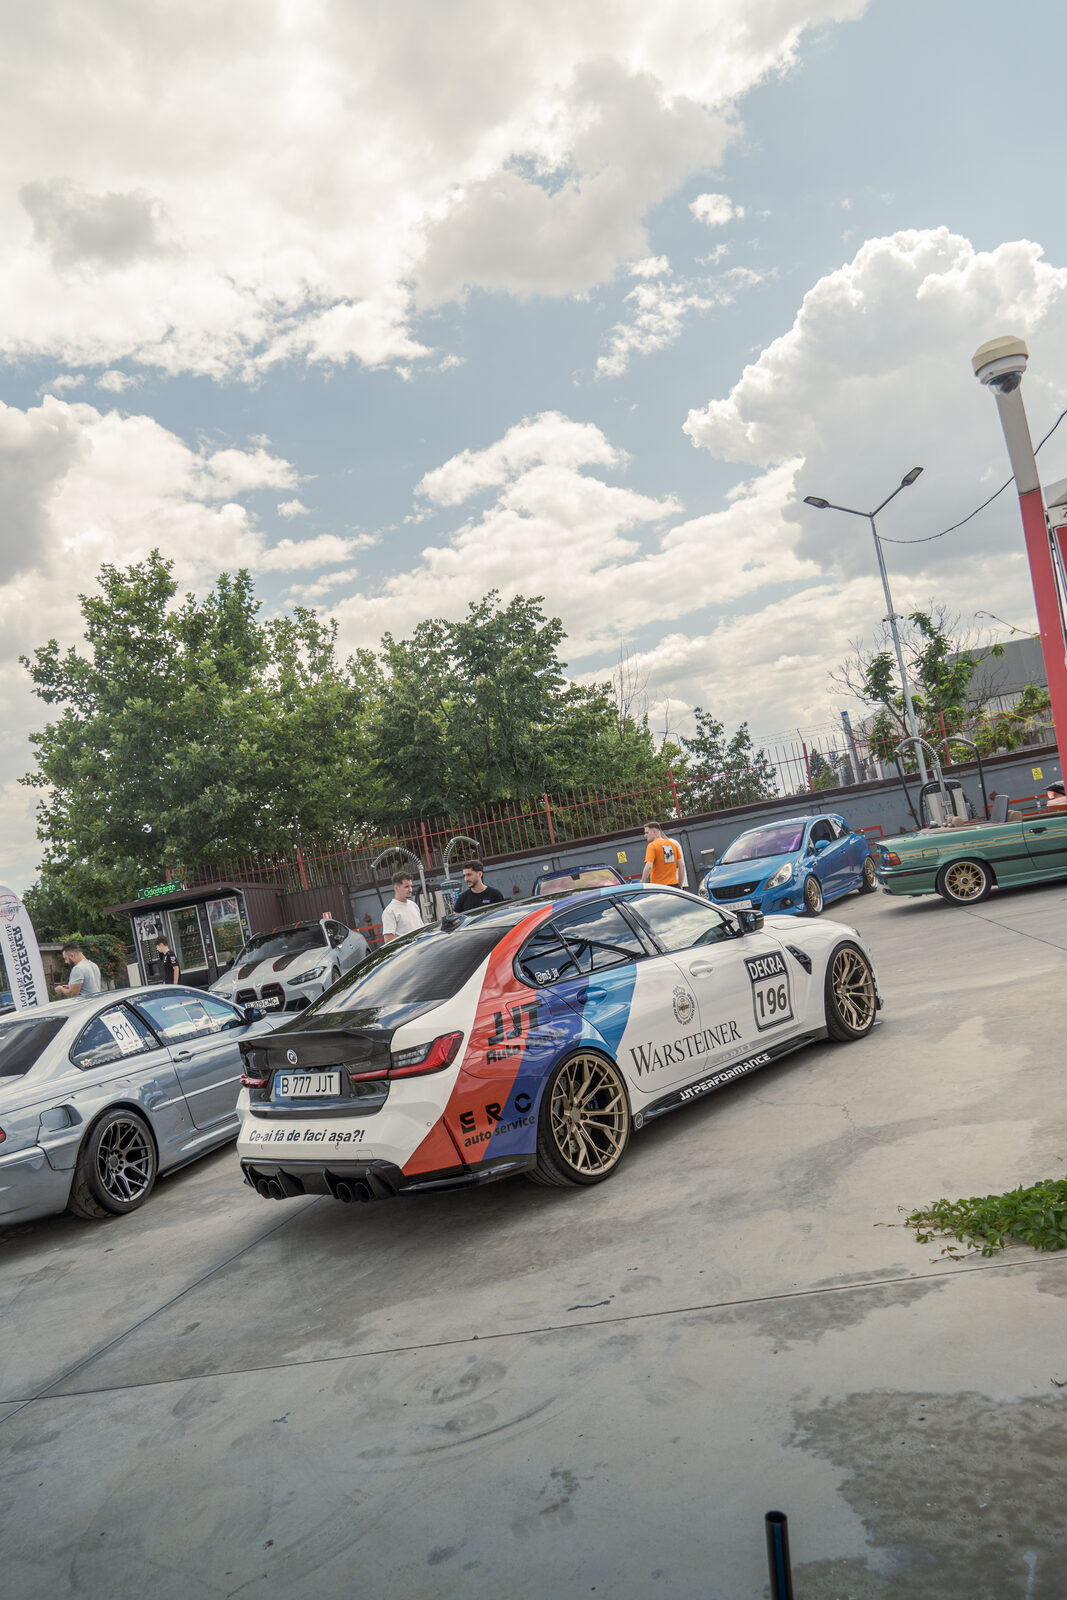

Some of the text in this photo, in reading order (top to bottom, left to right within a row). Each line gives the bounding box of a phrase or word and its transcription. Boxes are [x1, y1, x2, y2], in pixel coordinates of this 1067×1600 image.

[747, 955, 785, 980] DEKRA
[756, 983, 787, 1018] 196
[111, 1022, 136, 1041] 811
[488, 1000, 543, 1047] JJT
[486, 1044, 521, 1065] Auto
[629, 1020, 742, 1077] WARSTEINER
[281, 1074, 334, 1095] B 777 JJT
[249, 1129, 274, 1142] Ce-ai
[273, 1129, 285, 1142] fă
[286, 1129, 301, 1142] de
[302, 1128, 328, 1142] faci
[464, 1115, 536, 1148] auto service
